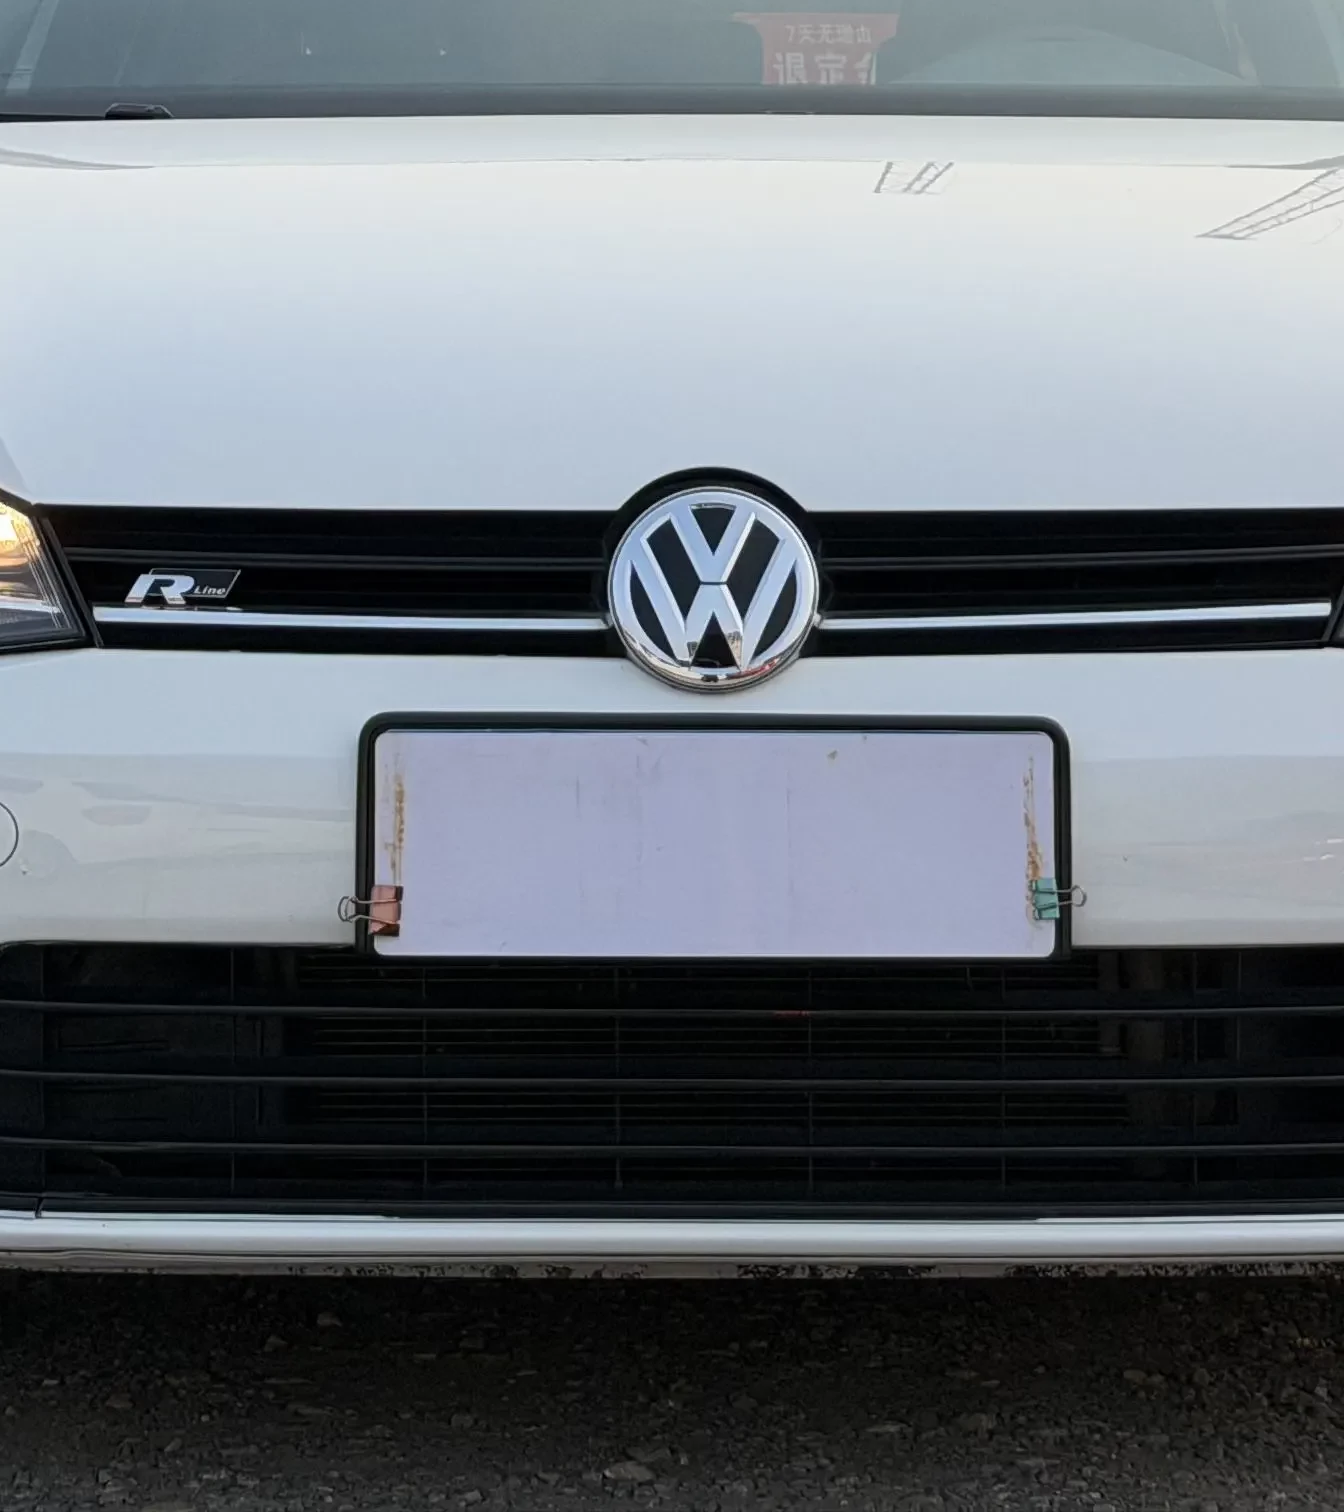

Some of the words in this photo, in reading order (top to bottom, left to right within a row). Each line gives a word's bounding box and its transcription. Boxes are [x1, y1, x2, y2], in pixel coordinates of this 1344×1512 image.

[785, 23, 872, 44] 7天无理由
[124, 574, 195, 605] R
